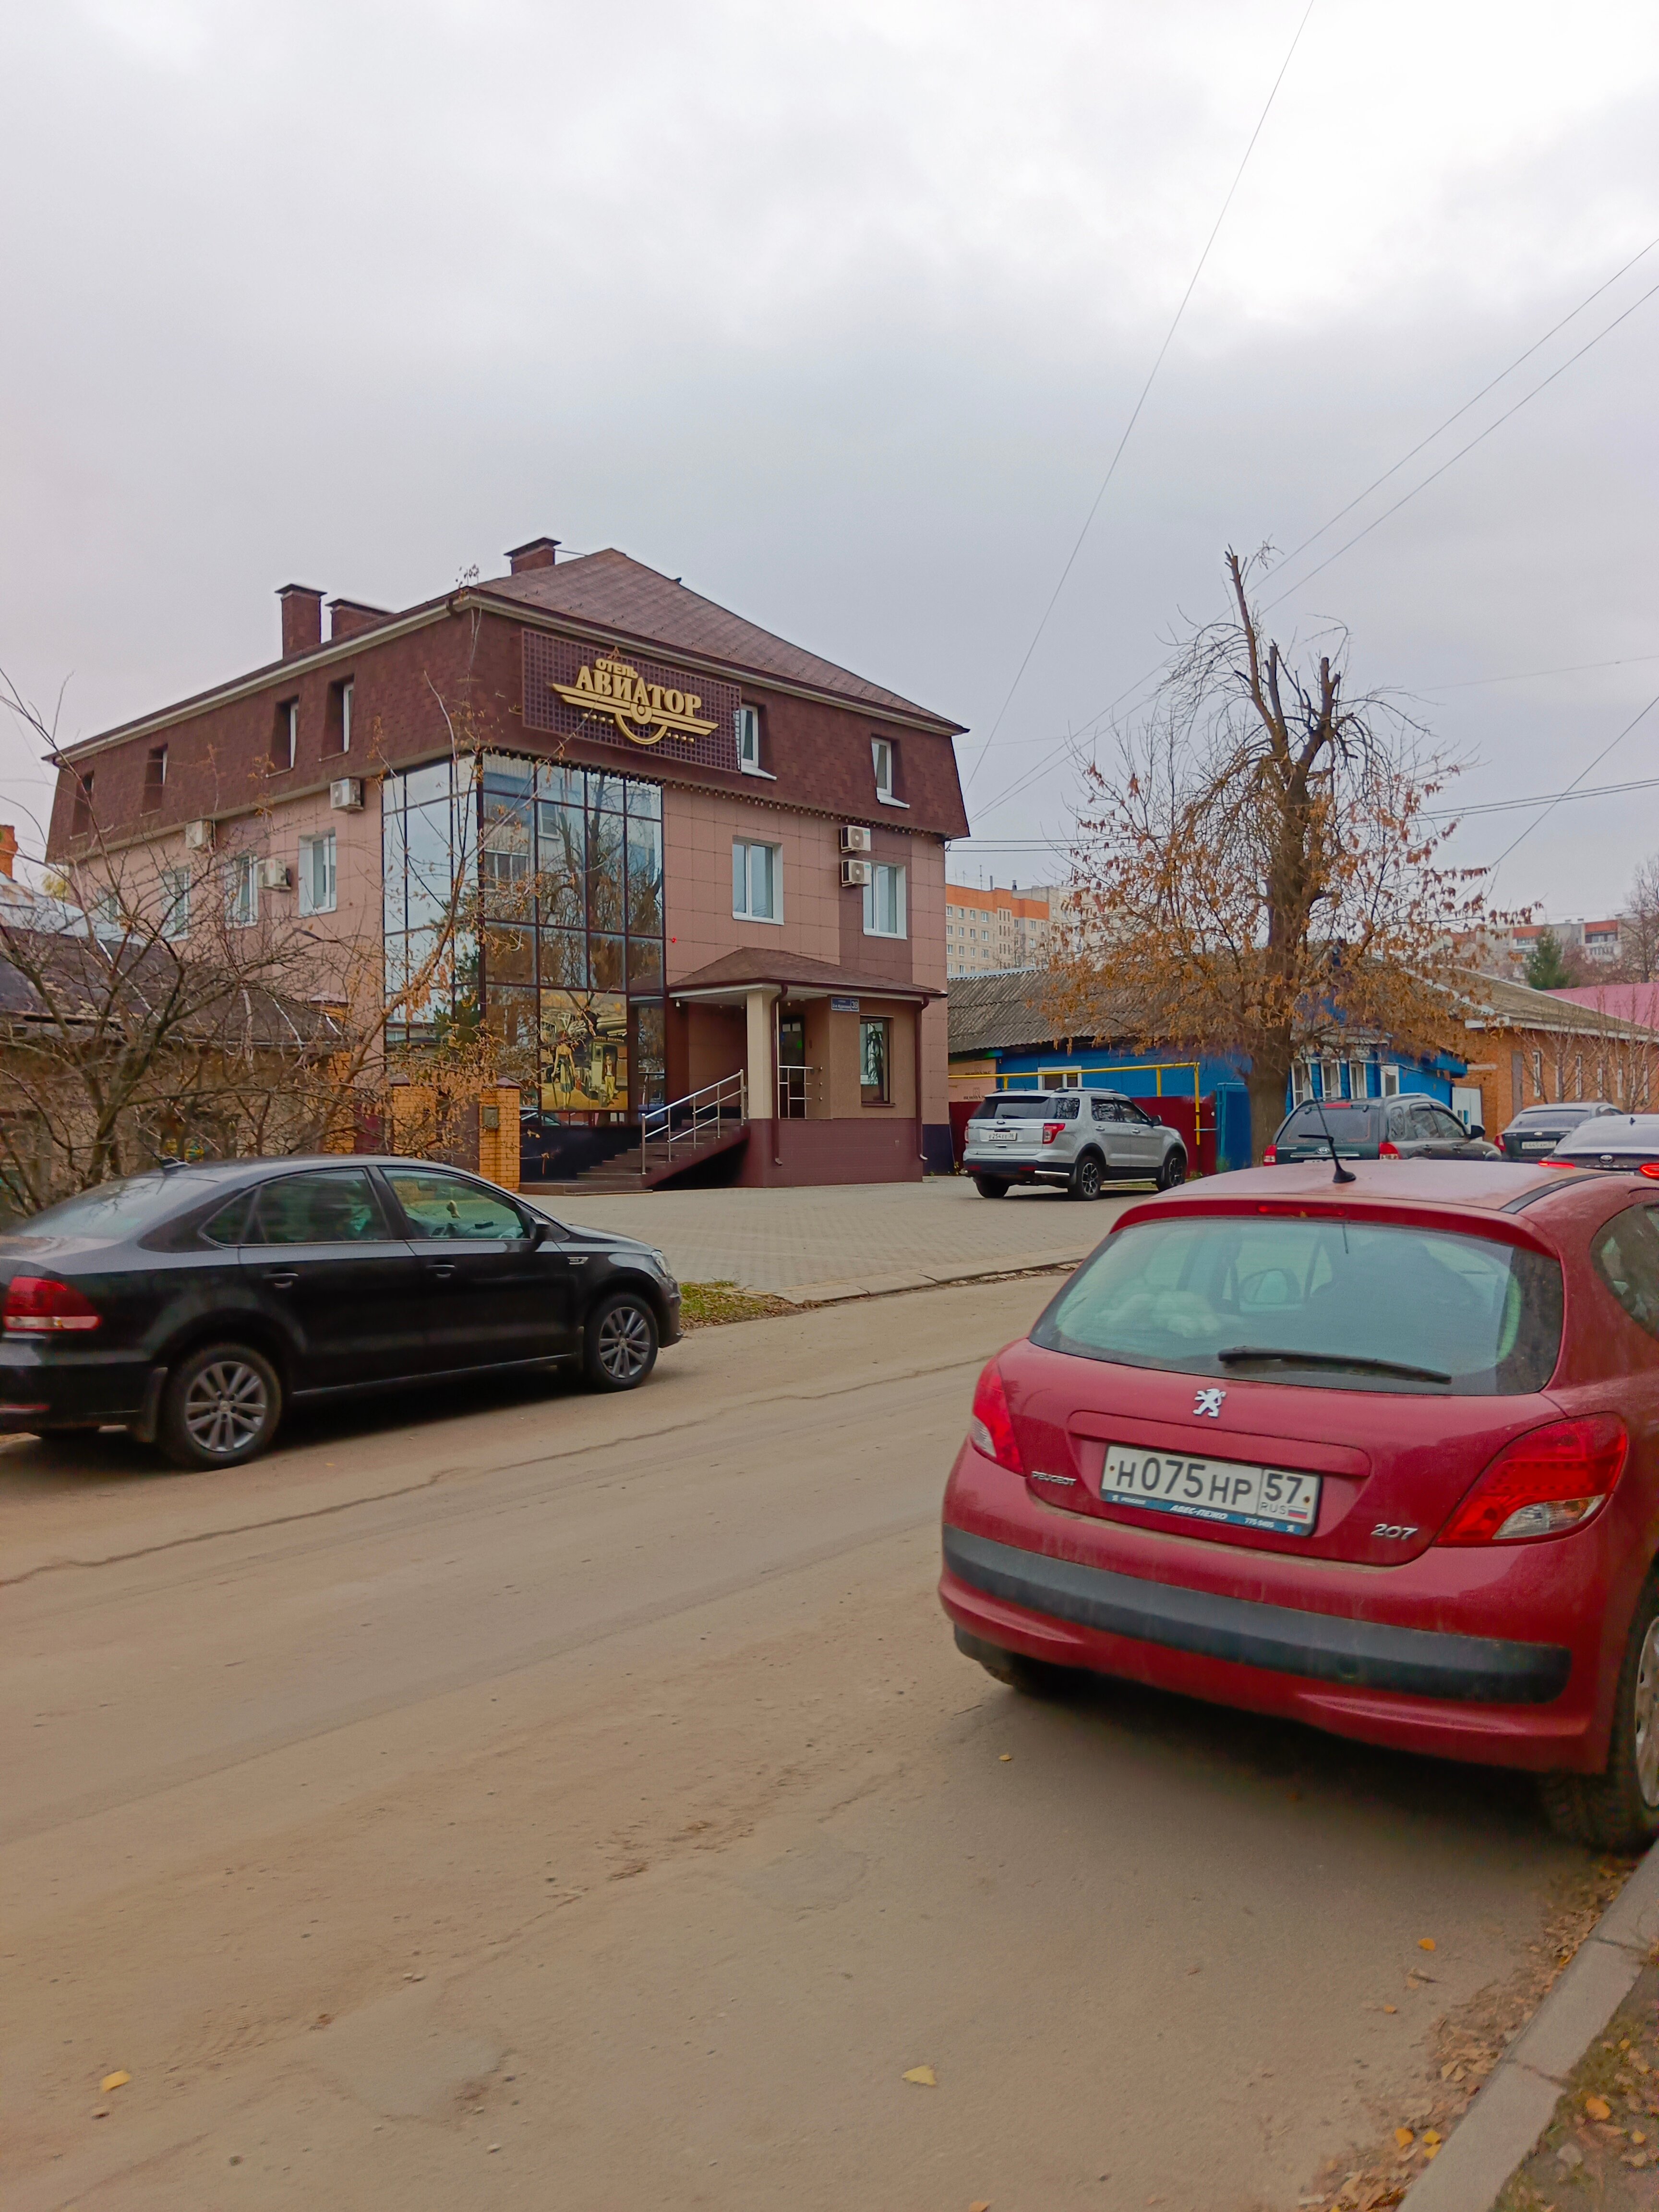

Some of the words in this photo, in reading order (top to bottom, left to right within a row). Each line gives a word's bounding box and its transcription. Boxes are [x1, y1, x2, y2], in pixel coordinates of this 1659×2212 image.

[596, 658, 638, 678] ОТЕЛЬ
[576, 665, 702, 718] АВИАТОР
[1031, 1470, 1077, 1486] PEUGEOT
[1116, 1457, 1252, 1505] Н075НР
[1264, 1473, 1304, 1504] 57
[1260, 1502, 1287, 1515] RUS
[1370, 1523, 1419, 1540] 207
